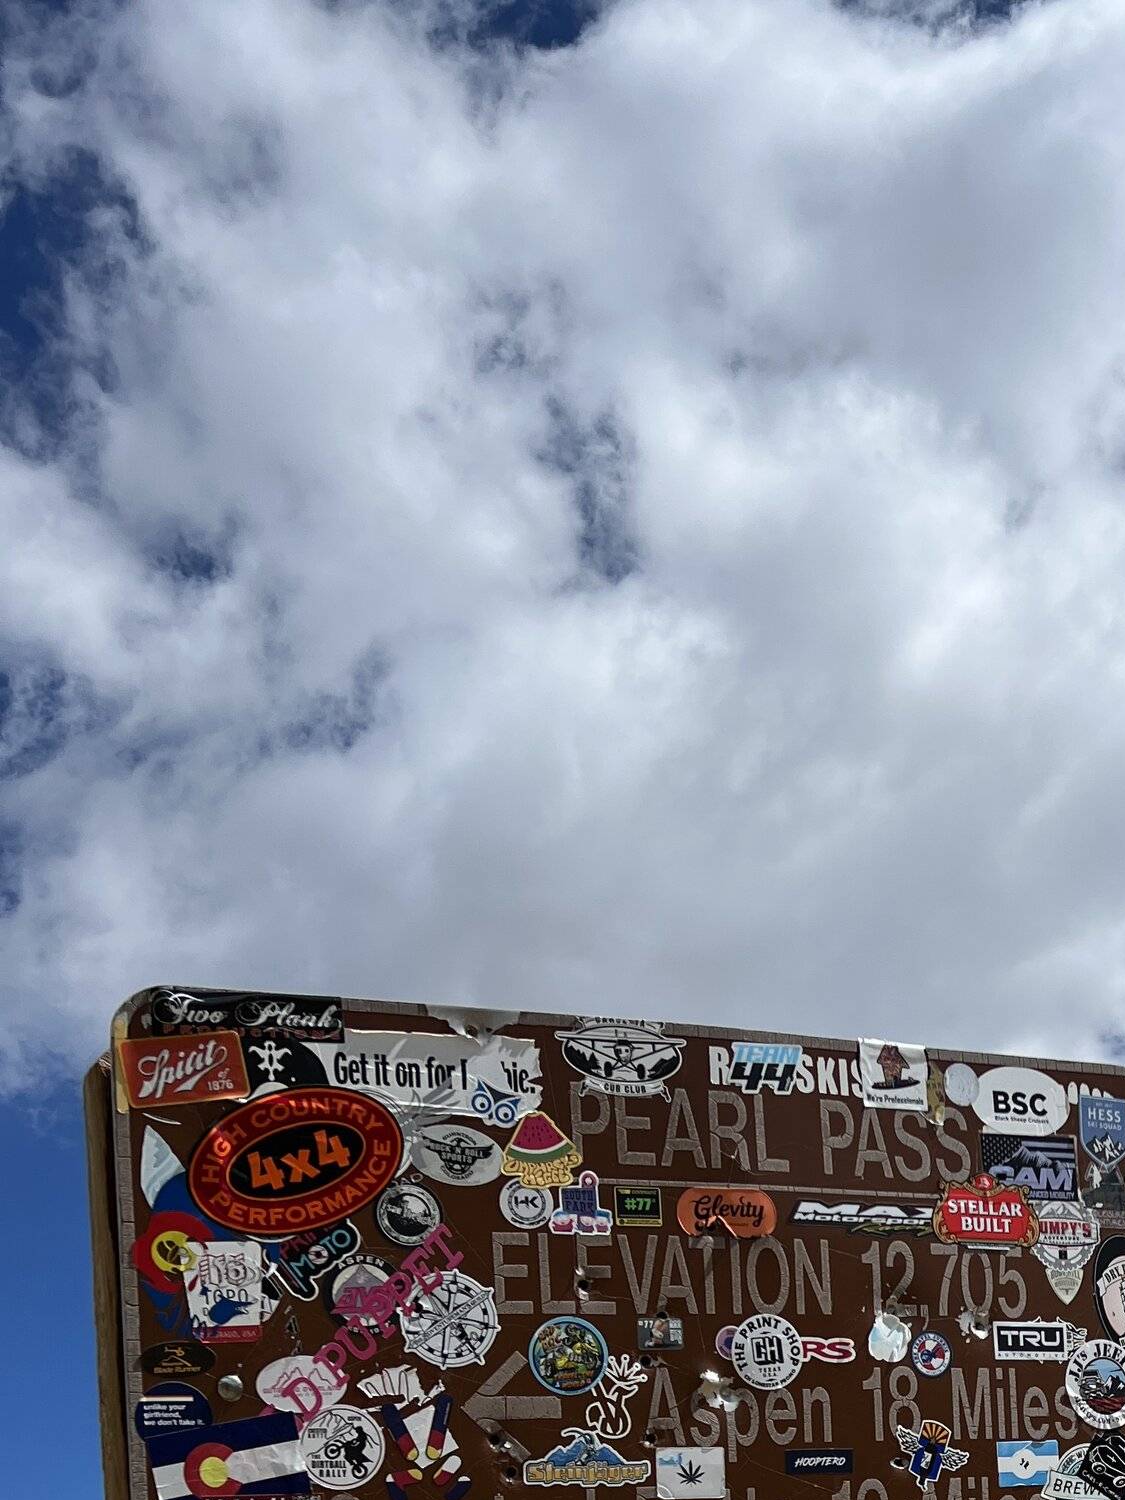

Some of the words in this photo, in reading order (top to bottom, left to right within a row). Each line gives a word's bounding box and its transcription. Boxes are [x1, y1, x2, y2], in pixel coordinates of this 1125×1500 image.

[153, 994, 225, 1025] Two
[235, 1000, 341, 1030] Plank
[334, 1051, 370, 1086] Get
[374, 1053, 391, 1087] it
[395, 1063, 421, 1088] on
[425, 1056, 456, 1090] for
[603, 1082, 622, 1093] CUB
[624, 1083, 647, 1094] CLUB
[992, 1090, 1049, 1117] BSC
[1088, 1107, 1121, 1124] HESS
[201, 1122, 248, 1184] HIGH
[251, 1097, 385, 1132] COUNTRY
[570, 1081, 790, 1174] PEARL
[820, 1098, 971, 1183] PASS
[247, 1129, 351, 1191] 4x4
[208, 1139, 392, 1227] PERFORMANCE
[988, 1164, 1075, 1193] CAM
[624, 1197, 652, 1212] #77
[692, 1194, 766, 1229] Glevity
[946, 1199, 1024, 1218] STELLAR
[960, 1215, 1013, 1234] BUILT
[1037, 1219, 1094, 1239] UMPY'S
[336, 1255, 386, 1270] ASPEN
[492, 1231, 833, 1316] ELEVATION
[1103, 1266, 1122, 1284] DRY
[740, 1316, 783, 1339] PRINT
[781, 1328, 801, 1367] SHOP
[999, 1329, 1062, 1348] TRU
[732, 1342, 750, 1372] THE
[802, 1341, 854, 1359] RS
[758, 1365, 782, 1374] TEXAS
[143, 1403, 168, 1411] unlike
[168, 1404, 187, 1413] your
[143, 1410, 182, 1420] girlfriend,
[647, 1367, 833, 1463] Aspen
[862, 1365, 922, 1443] 18
[950, 1366, 1078, 1441] Miles
[157, 1418, 178, 1426] don't
[178, 1417, 196, 1426] take
[311, 1460, 348, 1470] DIRTBALL
[318, 1469, 348, 1479] RALLY
[1053, 1478, 1101, 1497] BREW
